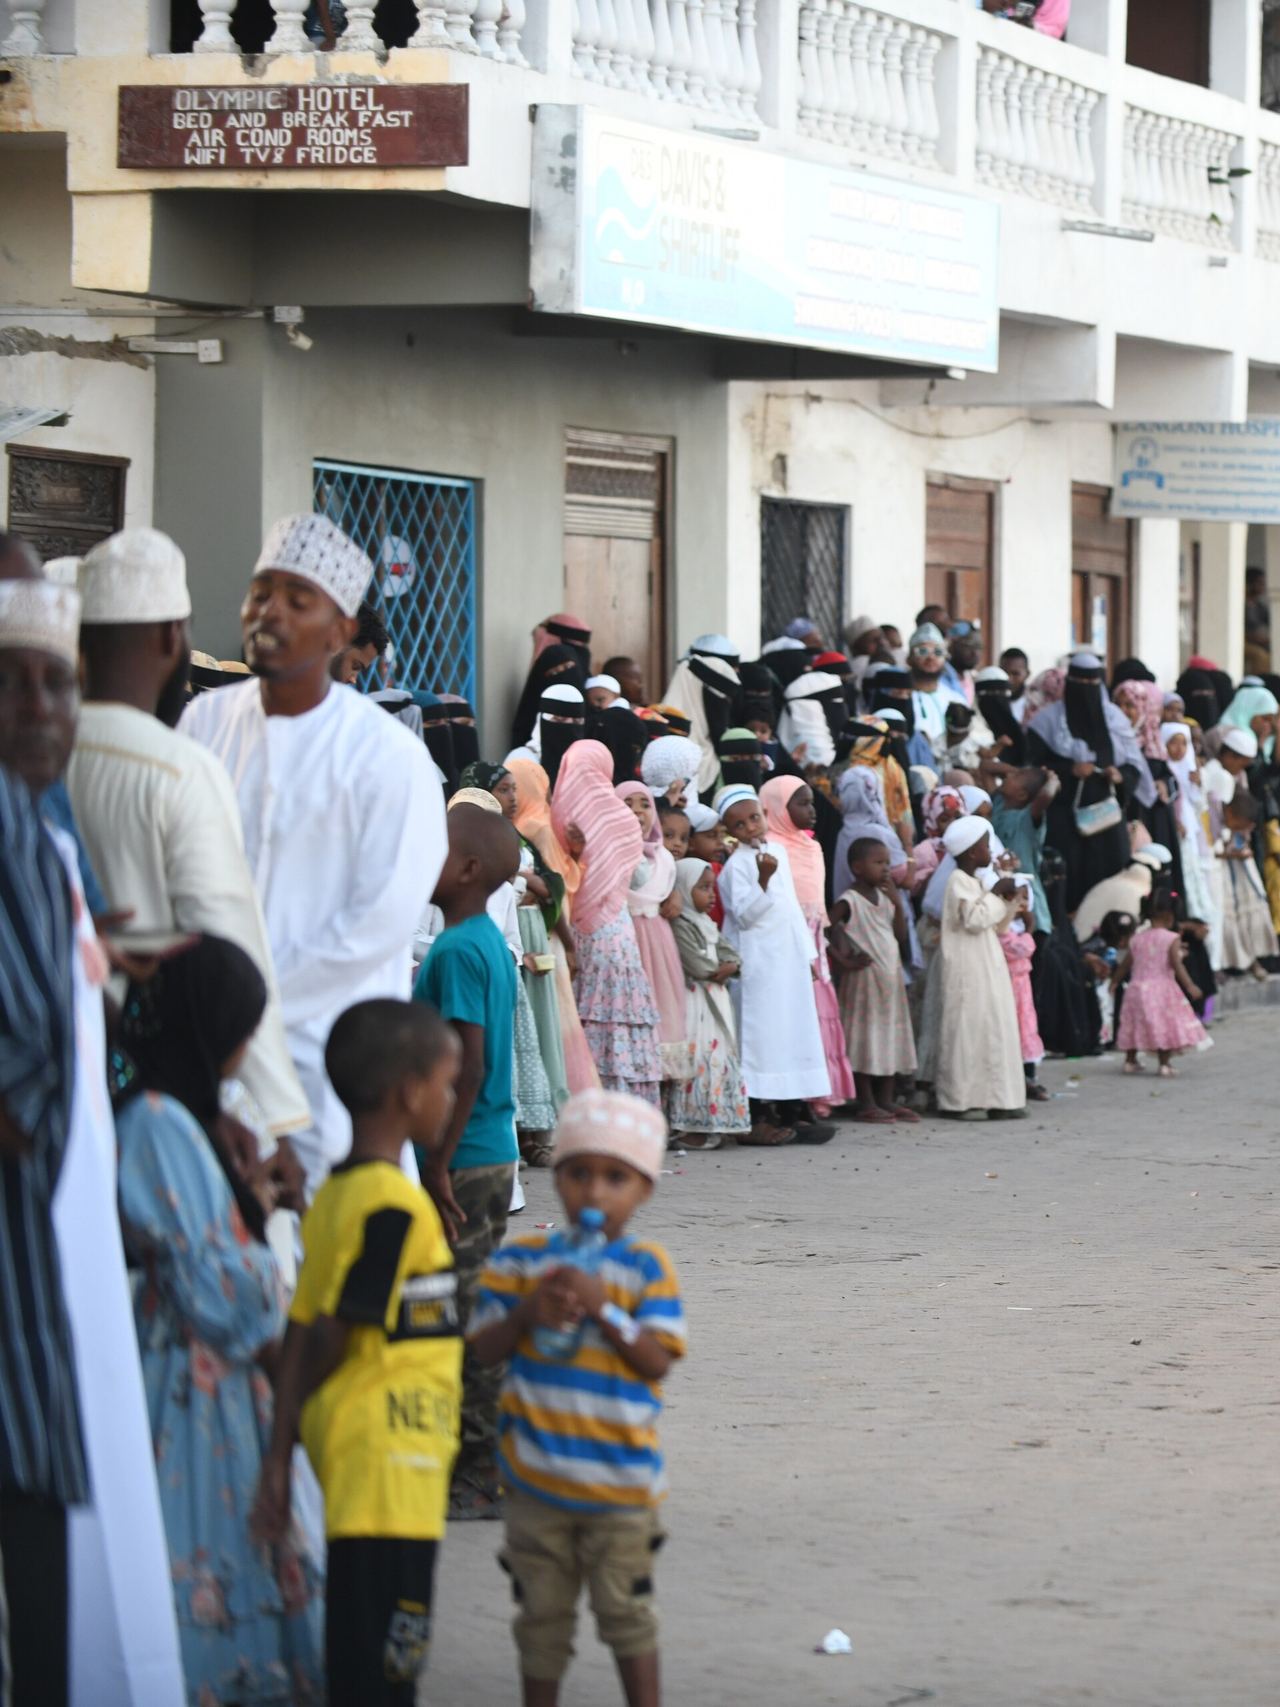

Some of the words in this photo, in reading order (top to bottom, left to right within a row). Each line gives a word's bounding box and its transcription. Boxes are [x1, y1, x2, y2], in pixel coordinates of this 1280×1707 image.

[174, 89, 283, 111] OLYMPIC
[298, 88, 384, 111] HOTEL
[173, 113, 212, 129] BED
[226, 112, 267, 128] AND
[282, 112, 350, 128] BREAK
[358, 111, 414, 128] FAST
[187, 130, 227, 147] AIR
[236, 129, 292, 147] COND
[306, 128, 372, 146] ROOMS
[184, 148, 226, 165] WIFI
[296, 147, 377, 164] FRIDGE
[660, 145, 713, 211] DAVIS
